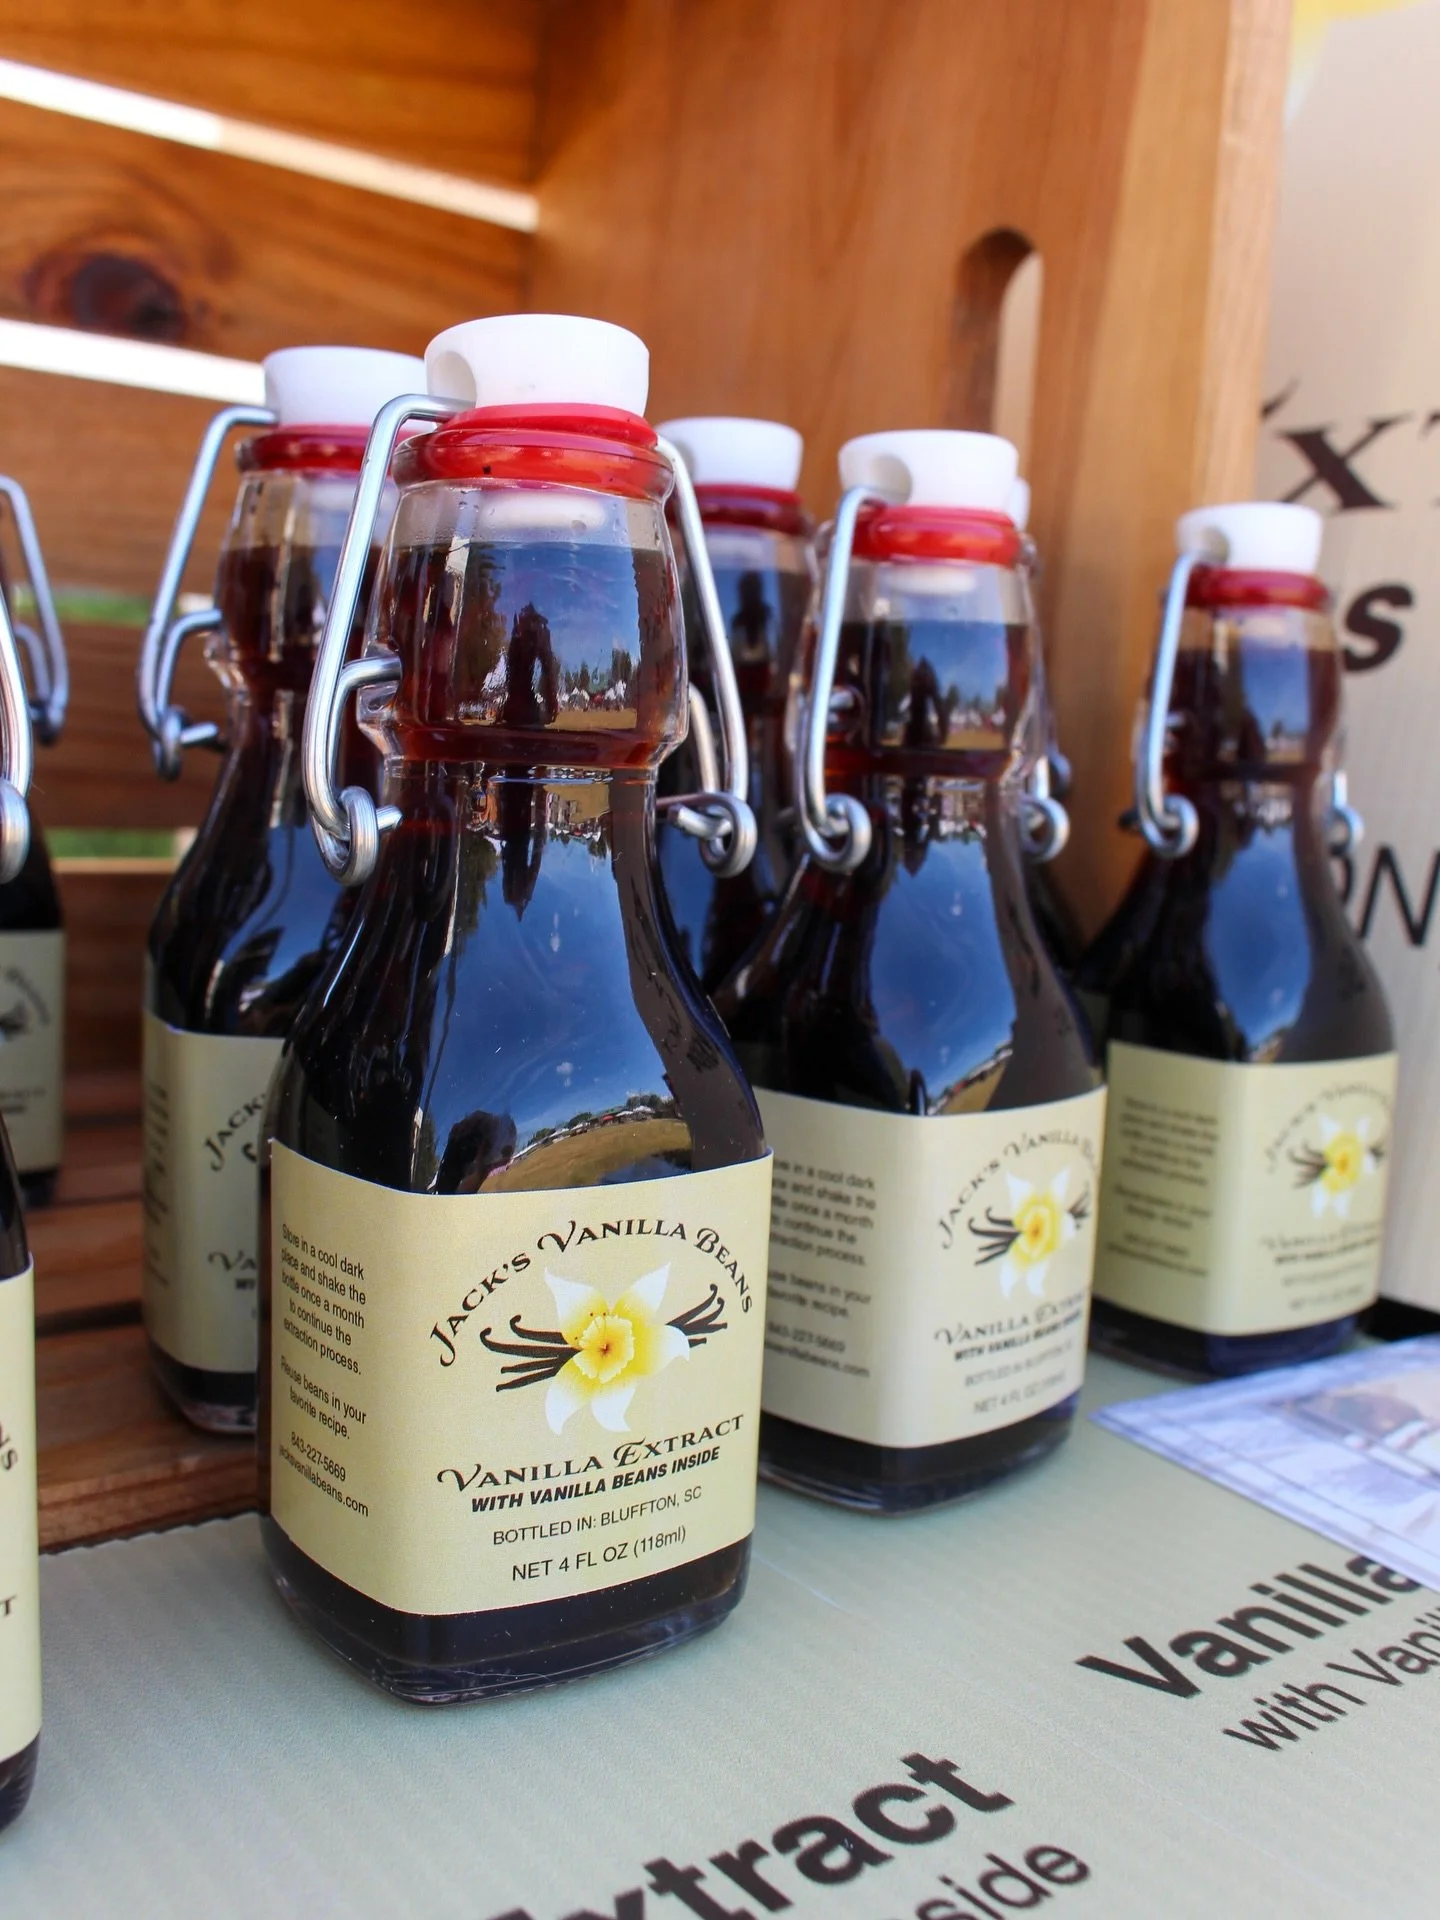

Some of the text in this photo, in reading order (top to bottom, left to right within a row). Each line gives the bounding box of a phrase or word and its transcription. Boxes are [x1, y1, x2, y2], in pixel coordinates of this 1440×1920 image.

[204, 1093, 267, 1172] JACK'
[281, 1248, 299, 1270] place
[300, 1262, 315, 1281] and
[318, 1271, 346, 1296] shake
[349, 1284, 366, 1305] the
[282, 1223, 364, 1280] Store in a cool dark
[282, 1270, 299, 1293] bottle
[301, 1286, 321, 1307] once
[324, 1301, 330, 1313] a
[333, 1303, 364, 1328] month
[289, 1297, 351, 1346] to continue the
[430, 1219, 753, 1367] JACK'S VANILLA BEANS
[284, 1318, 361, 1375] extraction process.
[934, 1313, 1029, 1346] VANILLA
[281, 1355, 366, 1424] Reuse beans in your
[289, 1385, 350, 1439] favorite recipe.
[291, 1431, 346, 1482] 843-227-5669
[437, 1414, 744, 1492] VANILLA EXTRACT
[471, 1446, 720, 1513] WITH VANILLA BEANS INSIDE
[493, 1486, 702, 1545] BOTTLED IN: BLUFFTON, SC
[512, 1525, 686, 1581] NET 4 FL OZ (118ml)
[1222, 1682, 1367, 1751] with
[488, 1752, 1014, 1920] tract
